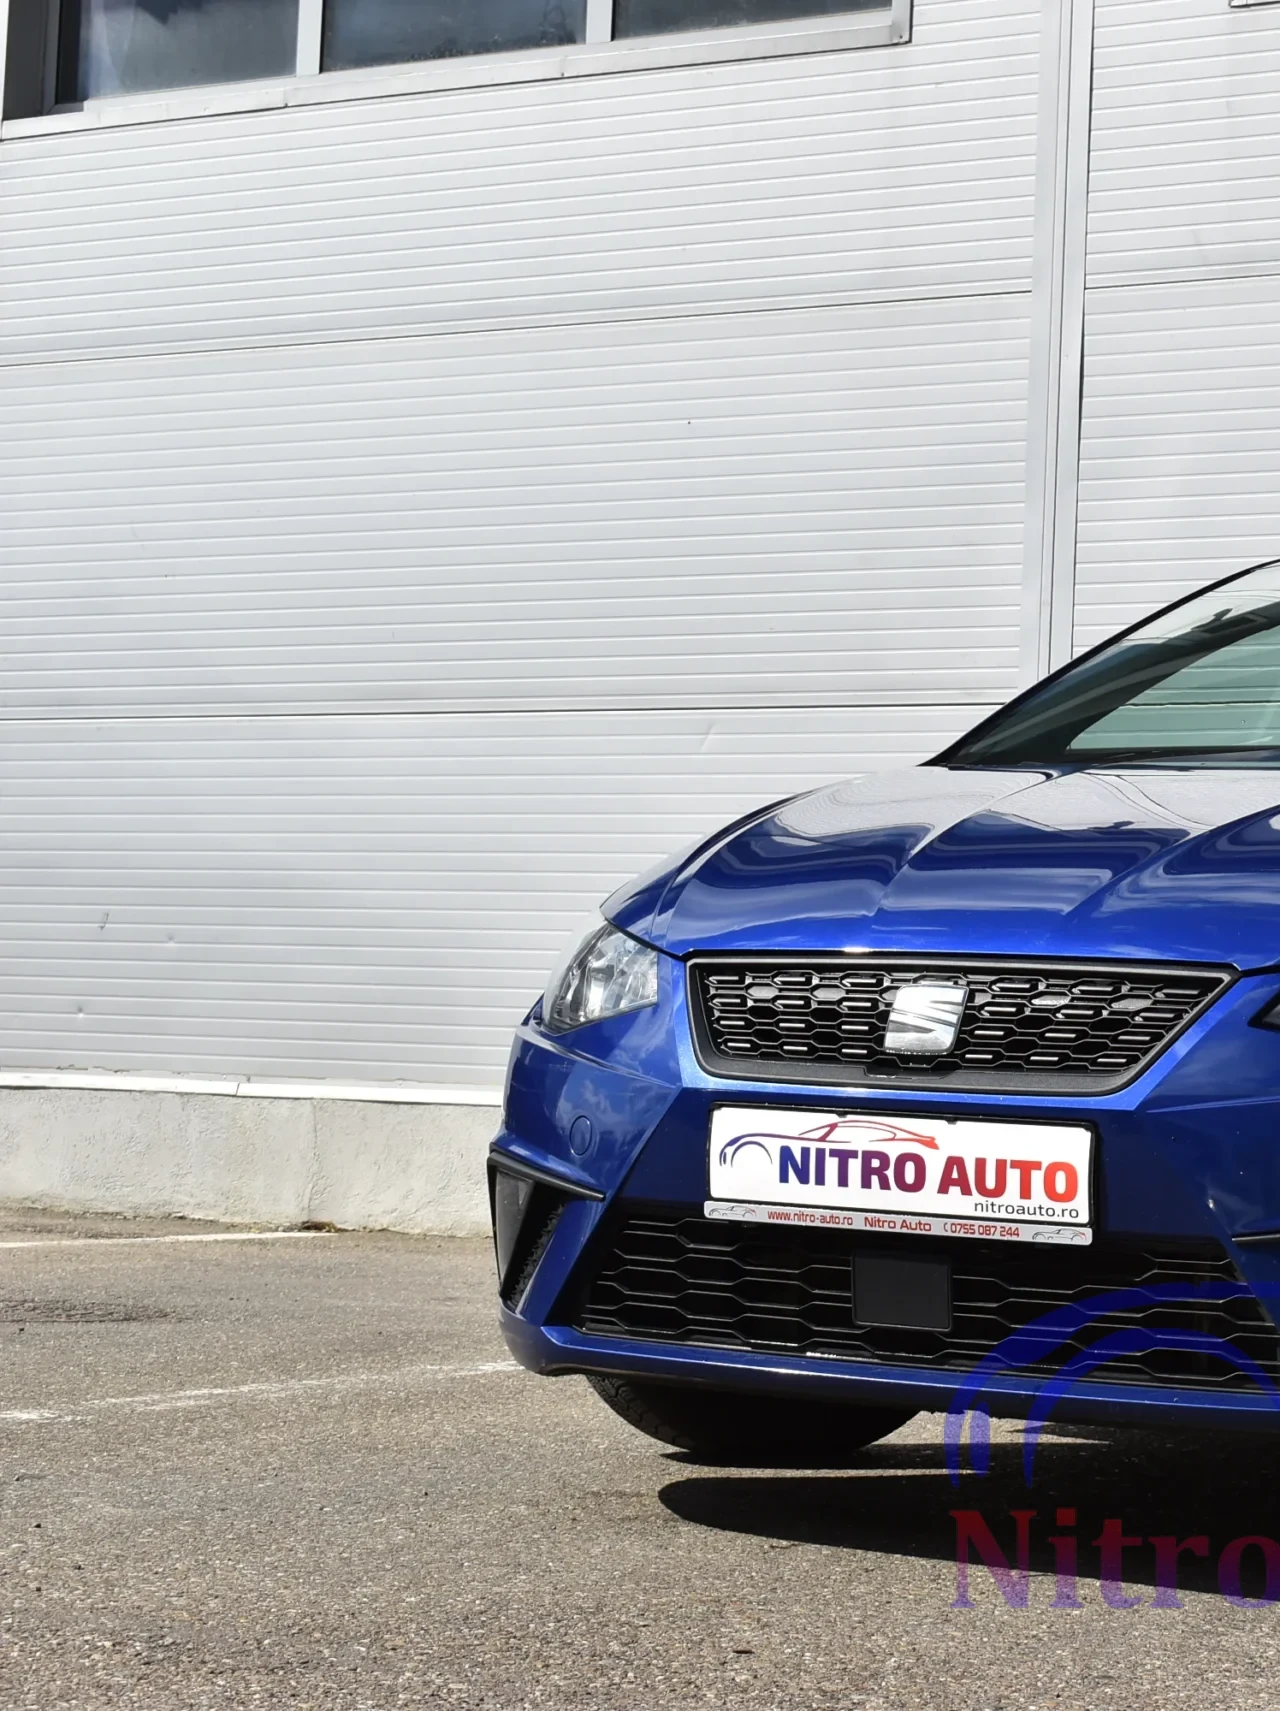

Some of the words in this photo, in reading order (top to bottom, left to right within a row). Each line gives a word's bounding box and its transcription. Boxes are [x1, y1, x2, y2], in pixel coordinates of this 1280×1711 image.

[779, 1145, 926, 1193] NITRO
[937, 1155, 1078, 1203] AUTO
[974, 1198, 1079, 1219] nitroauto.ro
[767, 1210, 854, 1226] www.nitro-auto.ro
[864, 1216, 897, 1231] Nitro
[900, 1220, 932, 1233] Auto
[950, 1223, 976, 1235] 0755
[977, 1225, 998, 1237] 087
[999, 1226, 1020, 1238] 244
